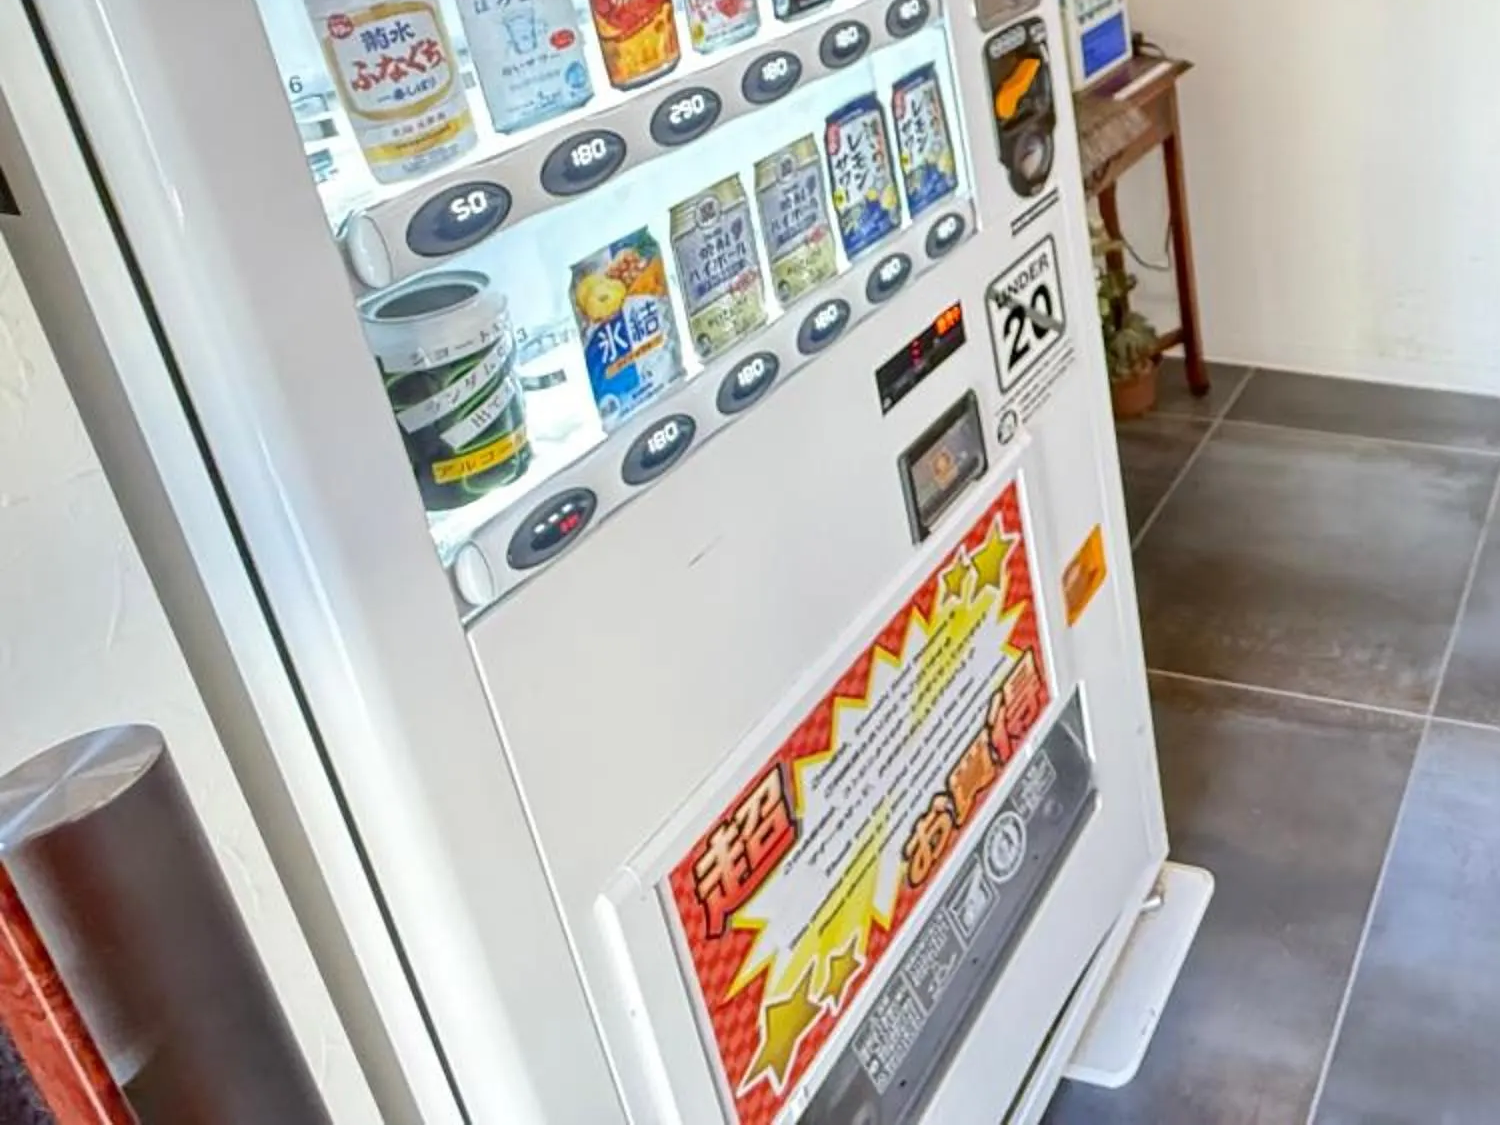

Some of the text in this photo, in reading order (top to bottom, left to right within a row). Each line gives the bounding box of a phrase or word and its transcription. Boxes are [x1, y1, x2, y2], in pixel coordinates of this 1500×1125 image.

[351, 37, 446, 92] ふなぐち
[668, 94, 706, 124] 290
[570, 137, 607, 167] 180
[597, 294, 662, 365] 氷結
[1003, 283, 1053, 373] 20
[647, 421, 679, 455] 180
[694, 762, 801, 939] 超
